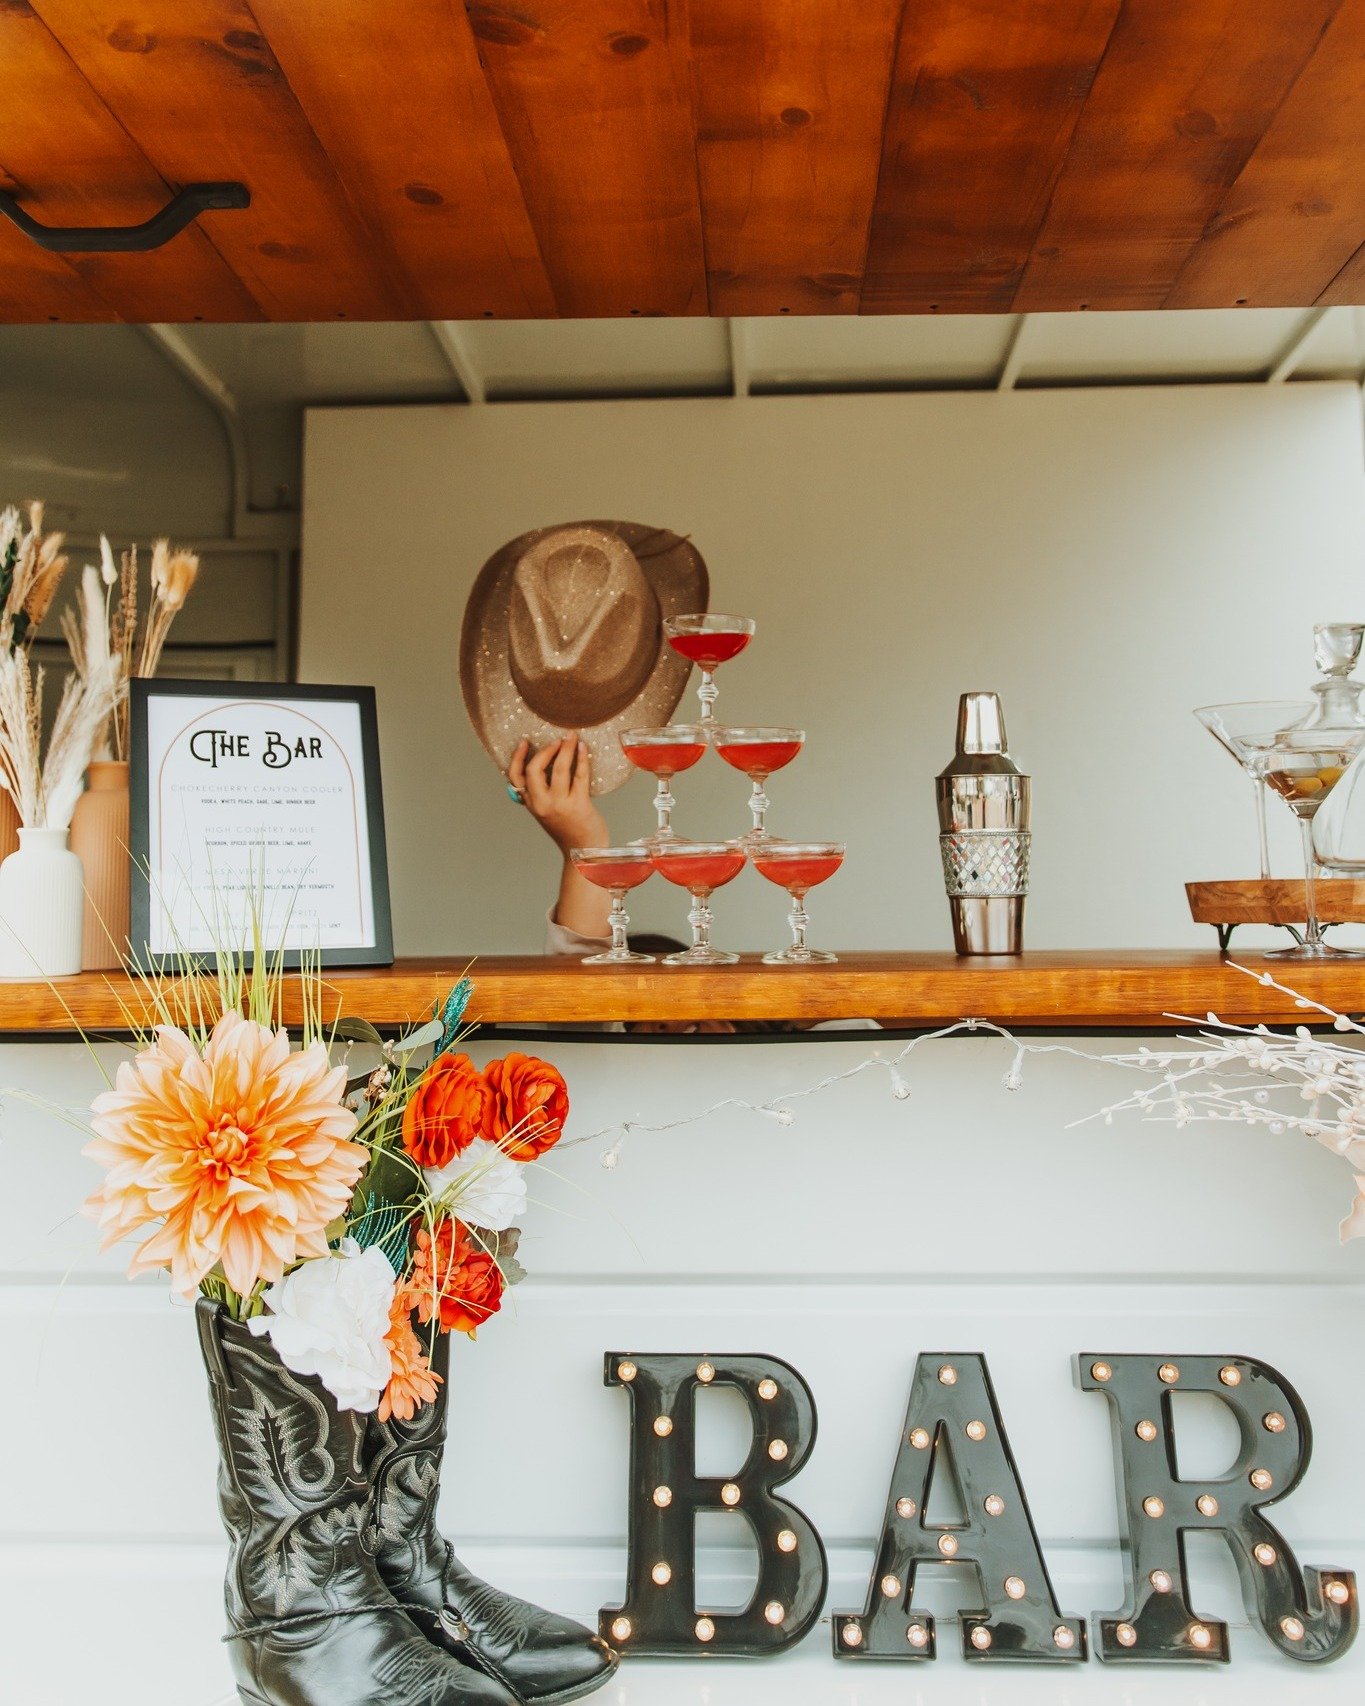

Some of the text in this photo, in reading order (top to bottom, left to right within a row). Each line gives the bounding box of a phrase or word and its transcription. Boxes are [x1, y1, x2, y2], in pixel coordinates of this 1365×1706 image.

[171, 784, 248, 792] CHOKECHERRY
[253, 785, 298, 793] CANYON
[600, 1352, 1359, 1665] BAR
